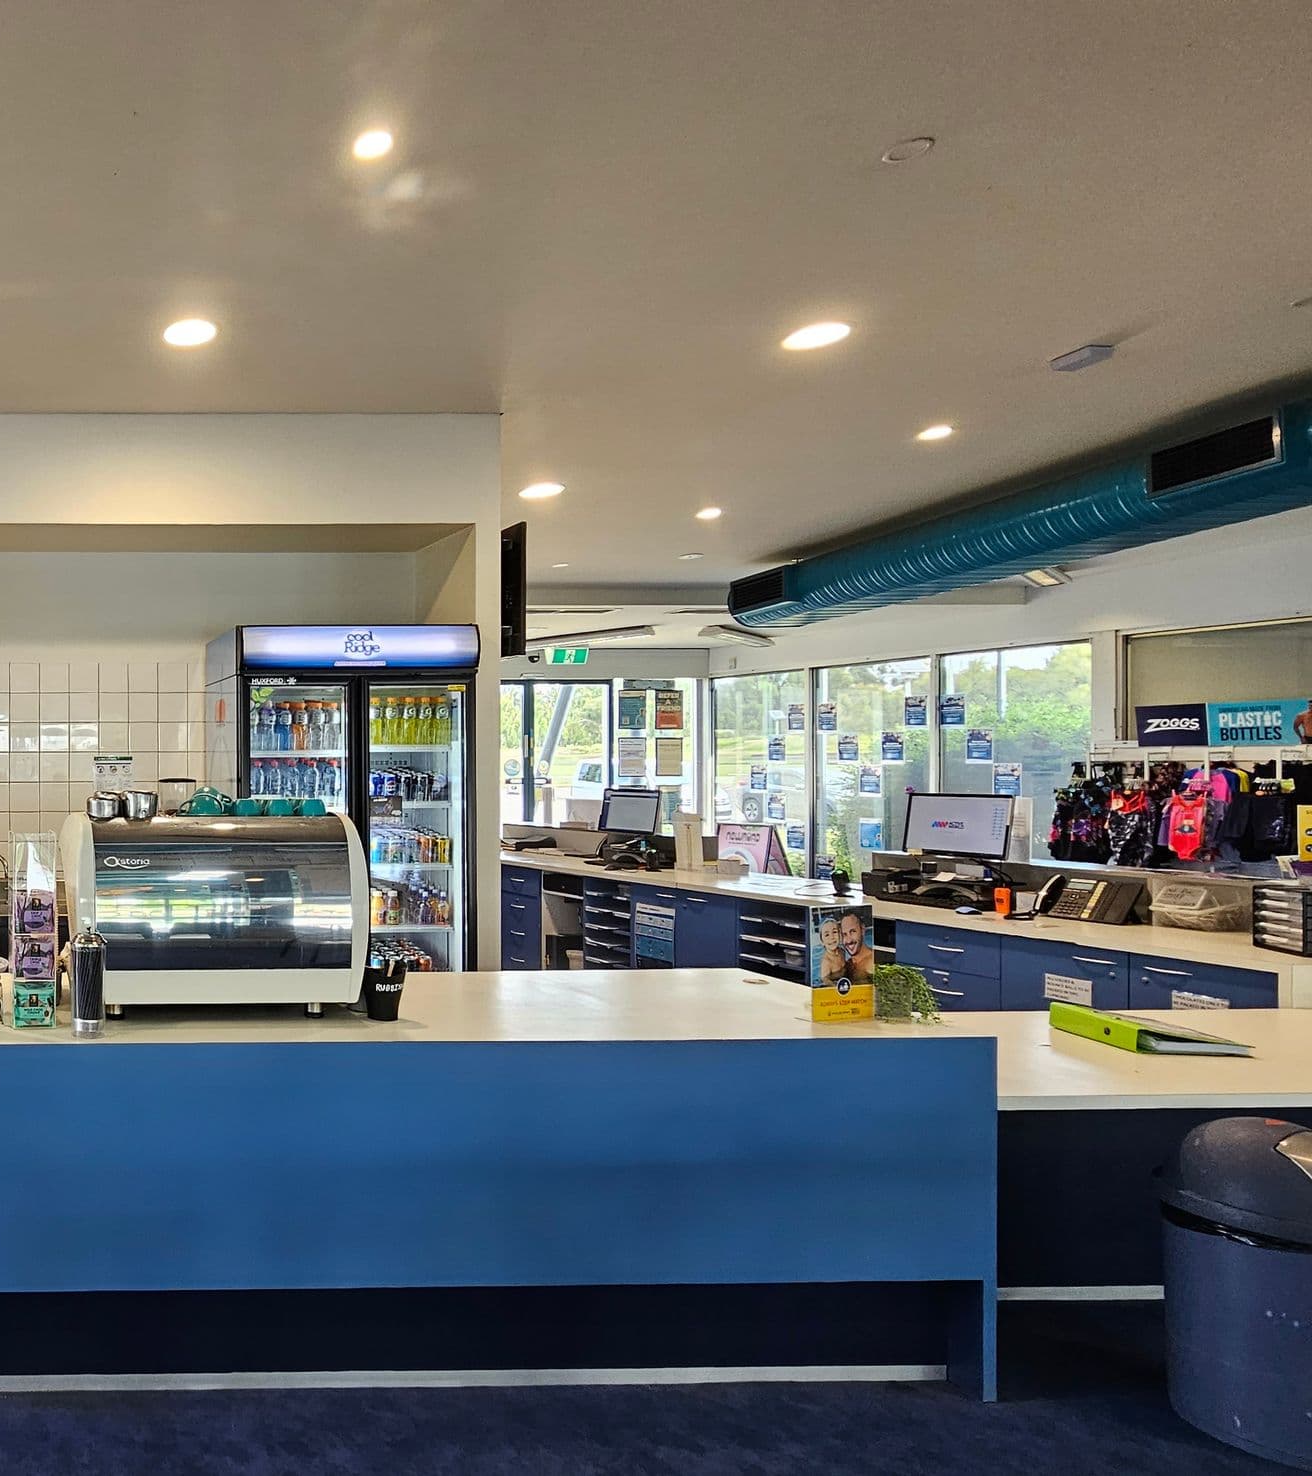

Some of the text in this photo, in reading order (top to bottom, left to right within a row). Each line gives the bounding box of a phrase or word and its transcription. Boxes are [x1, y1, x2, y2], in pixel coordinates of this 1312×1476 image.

[347, 630, 374, 642] cool
[344, 641, 381, 656] Ridge
[1144, 718, 1200, 734] ZOGGS
[1220, 727, 1282, 742] BOTTLES
